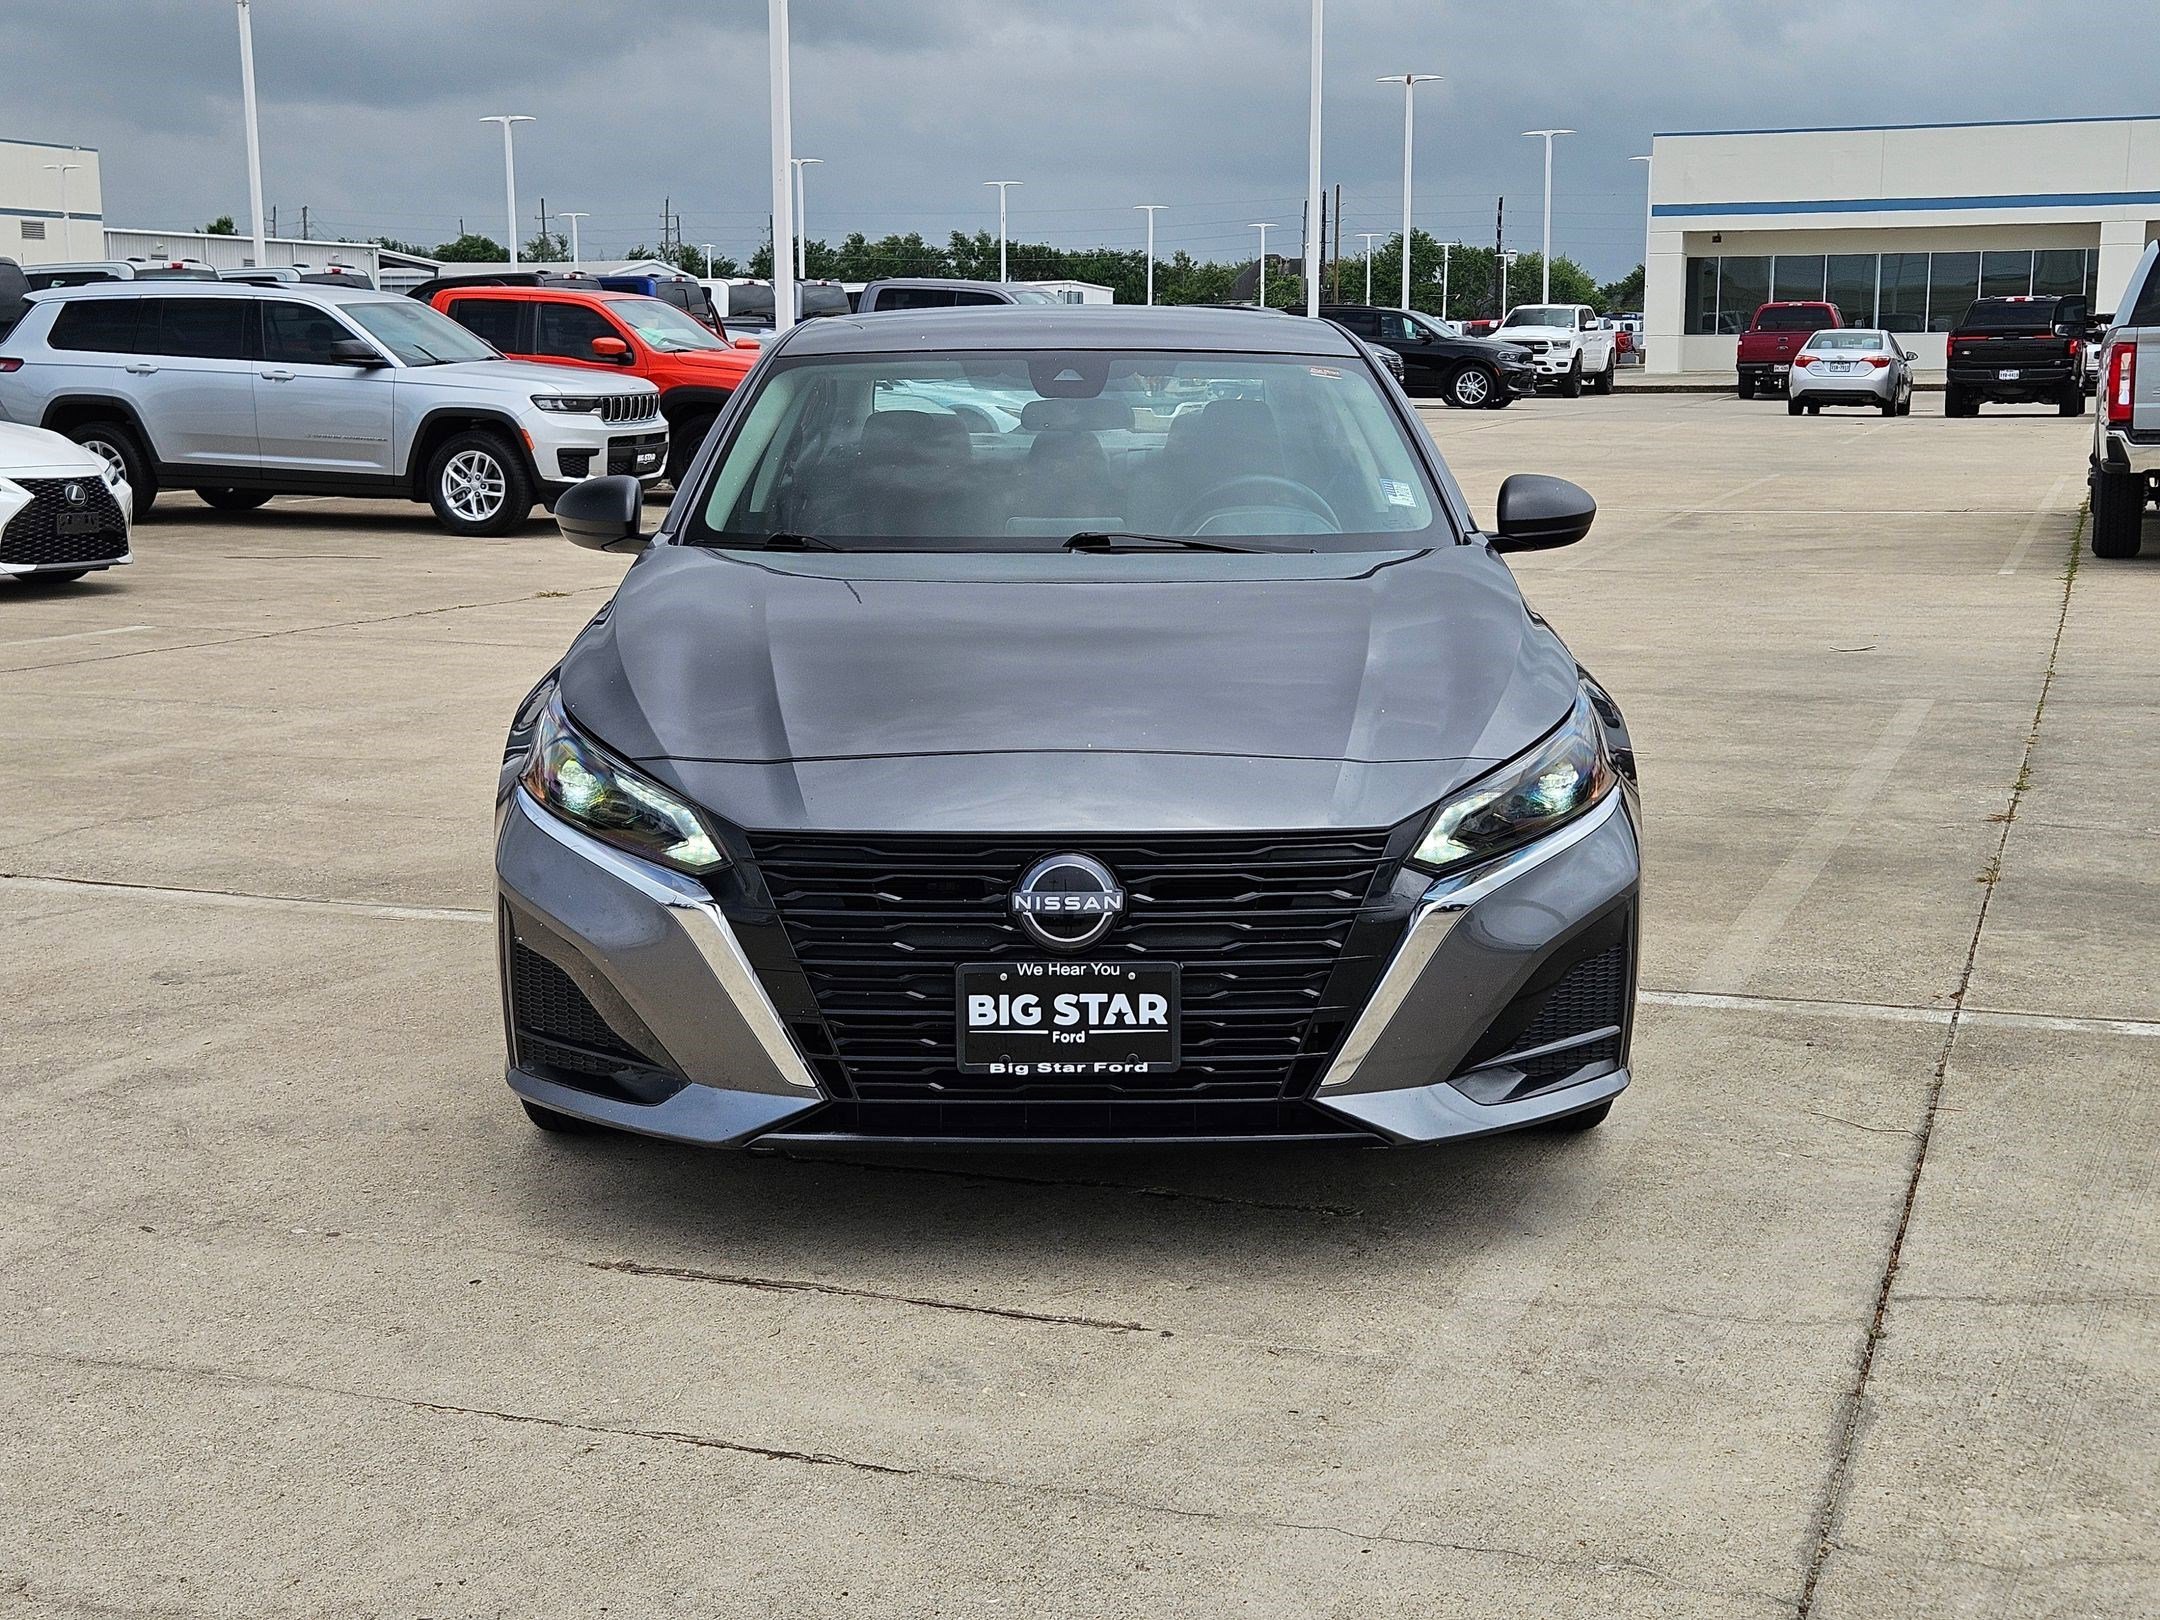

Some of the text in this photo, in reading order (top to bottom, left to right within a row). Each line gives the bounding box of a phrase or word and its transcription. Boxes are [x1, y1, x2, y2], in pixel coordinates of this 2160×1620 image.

[1015, 895, 1121, 911] NISSAN
[1016, 963, 1120, 976] We Hear You
[968, 993, 1168, 1026] BIG STAR
[1052, 1031, 1086, 1044] Ford
[989, 1062, 1148, 1076] Big Star Ford
